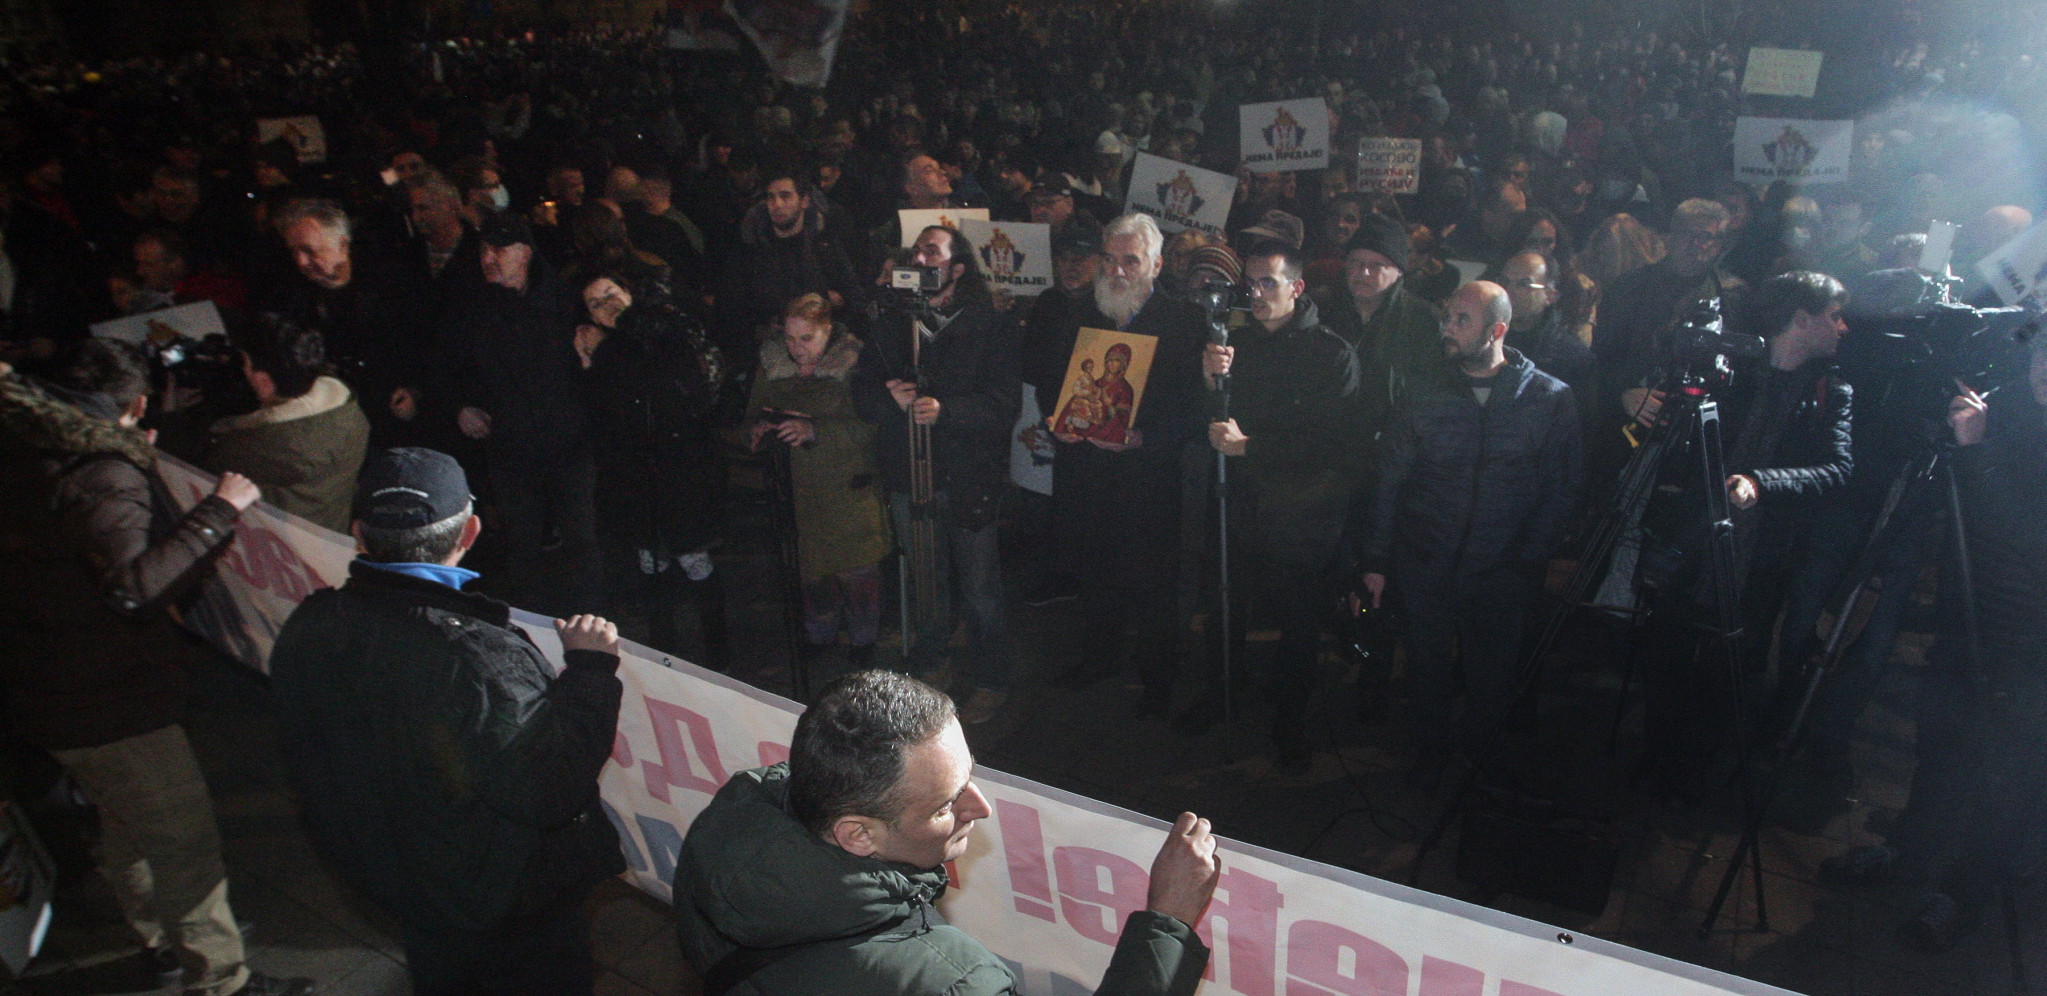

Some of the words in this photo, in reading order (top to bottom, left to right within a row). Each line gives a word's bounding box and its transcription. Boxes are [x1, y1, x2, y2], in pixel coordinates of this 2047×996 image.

[1246, 152, 1274, 162] НЕМА
[1275, 148, 1323, 160] ПРЕДАЈЕ!
[1360, 152, 1416, 163] КОСОВО
[1740, 166, 1775, 176] НЕМА
[1776, 166, 1841, 177] ПРЕДАЈЕ!
[1359, 179, 1414, 190] РУСИЈУ
[1131, 202, 1162, 218] НЕМА
[994, 275, 1047, 285] ПРЕДАЈЕ!
[1997, 257, 2027, 296] НЕМА
